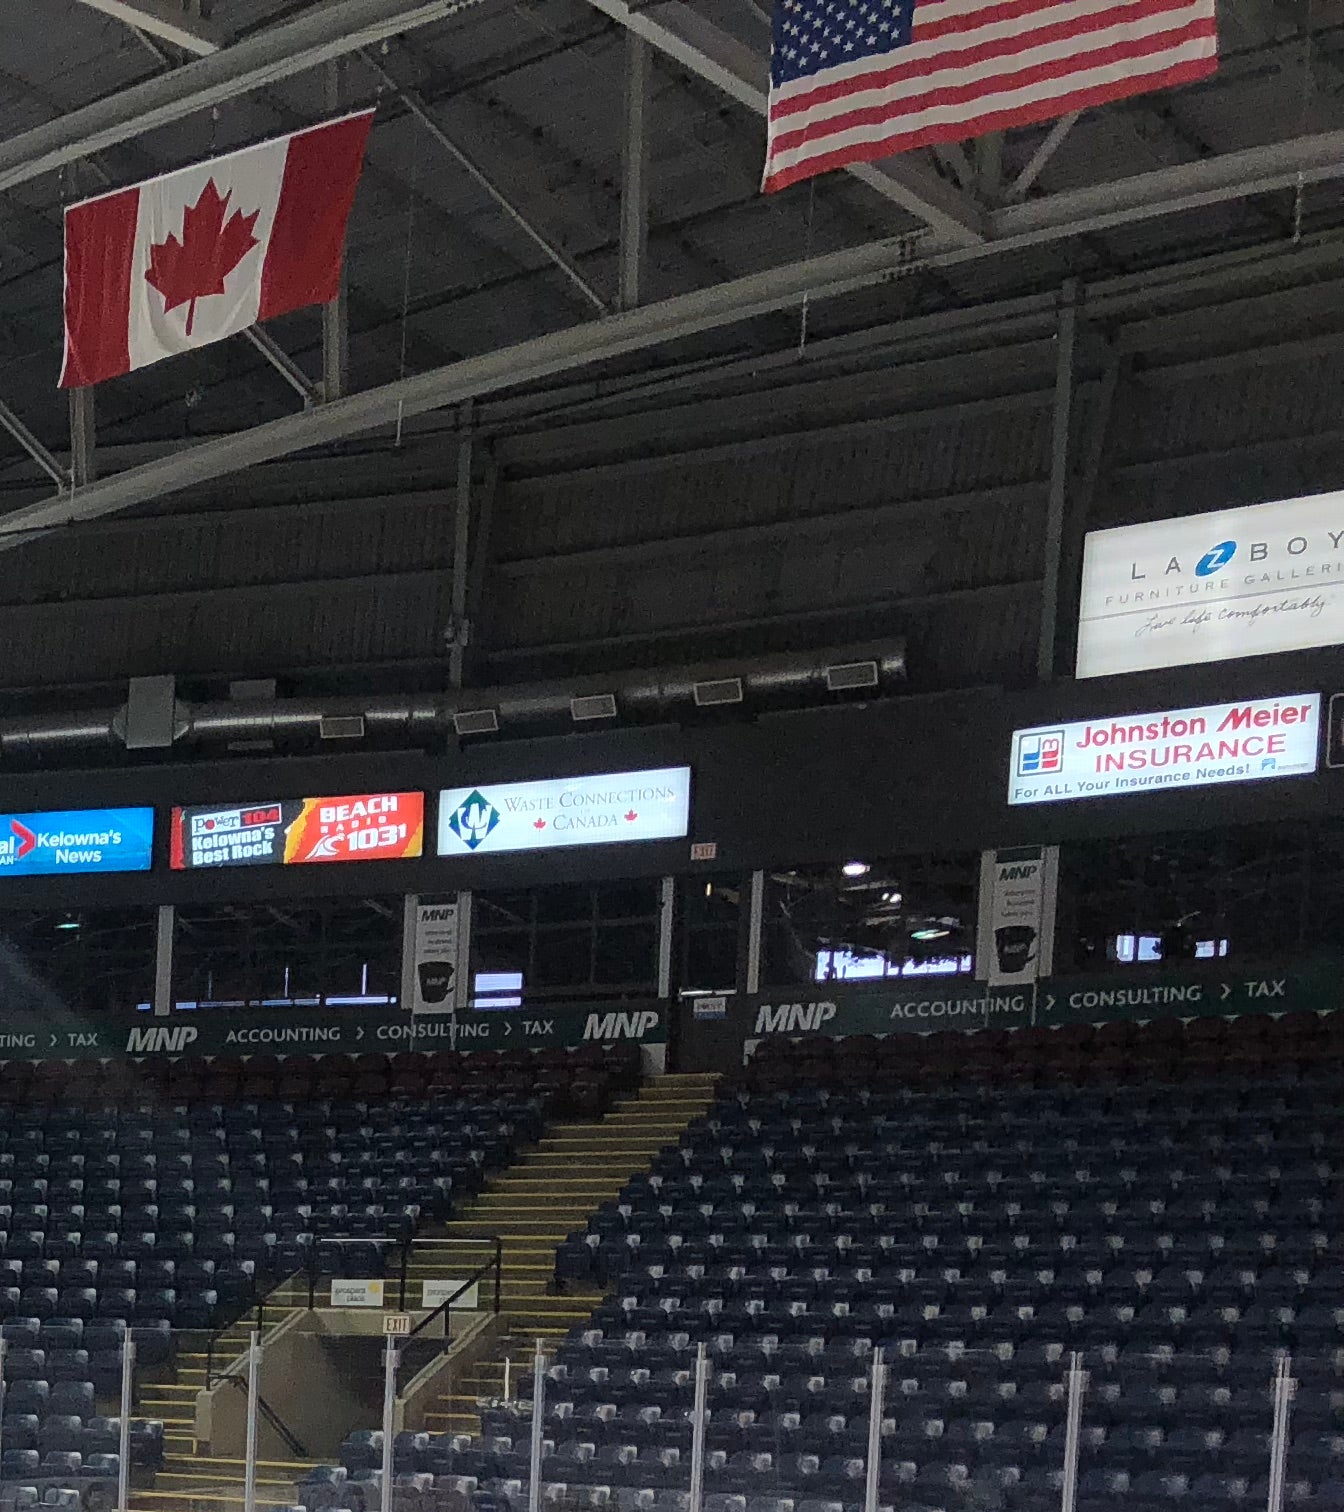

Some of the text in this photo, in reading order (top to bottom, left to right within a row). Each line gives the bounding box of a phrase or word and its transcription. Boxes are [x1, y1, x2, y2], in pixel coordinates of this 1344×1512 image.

[1106, 579, 1229, 606] FURNITURE
[1182, 607, 1212, 633] life
[1218, 594, 1327, 627] comfortably
[1076, 703, 1312, 749] Johnston Meier
[1095, 733, 1287, 773] INSURANCE
[1015, 763, 1250, 799] For ALL Your Insurance Needs!
[242, 809, 280, 824] 104
[319, 796, 398, 823] BEACH
[36, 830, 122, 849] Kelowna's
[193, 828, 274, 850] Kelowna's
[55, 848, 102, 865] News
[193, 841, 273, 865] Best Rock
[999, 866, 1037, 881] MNP
[421, 909, 454, 921] MNP
[755, 979, 1285, 1033] MNP ACCOUNTING CONSULTING TAX
[126, 1020, 554, 1051] MNP ACCOUNTING CONSULTING TAX
[583, 1012, 658, 1040] MNP
[68, 1032, 98, 1047] TAX
[386, 1318, 408, 1332] EXIT
